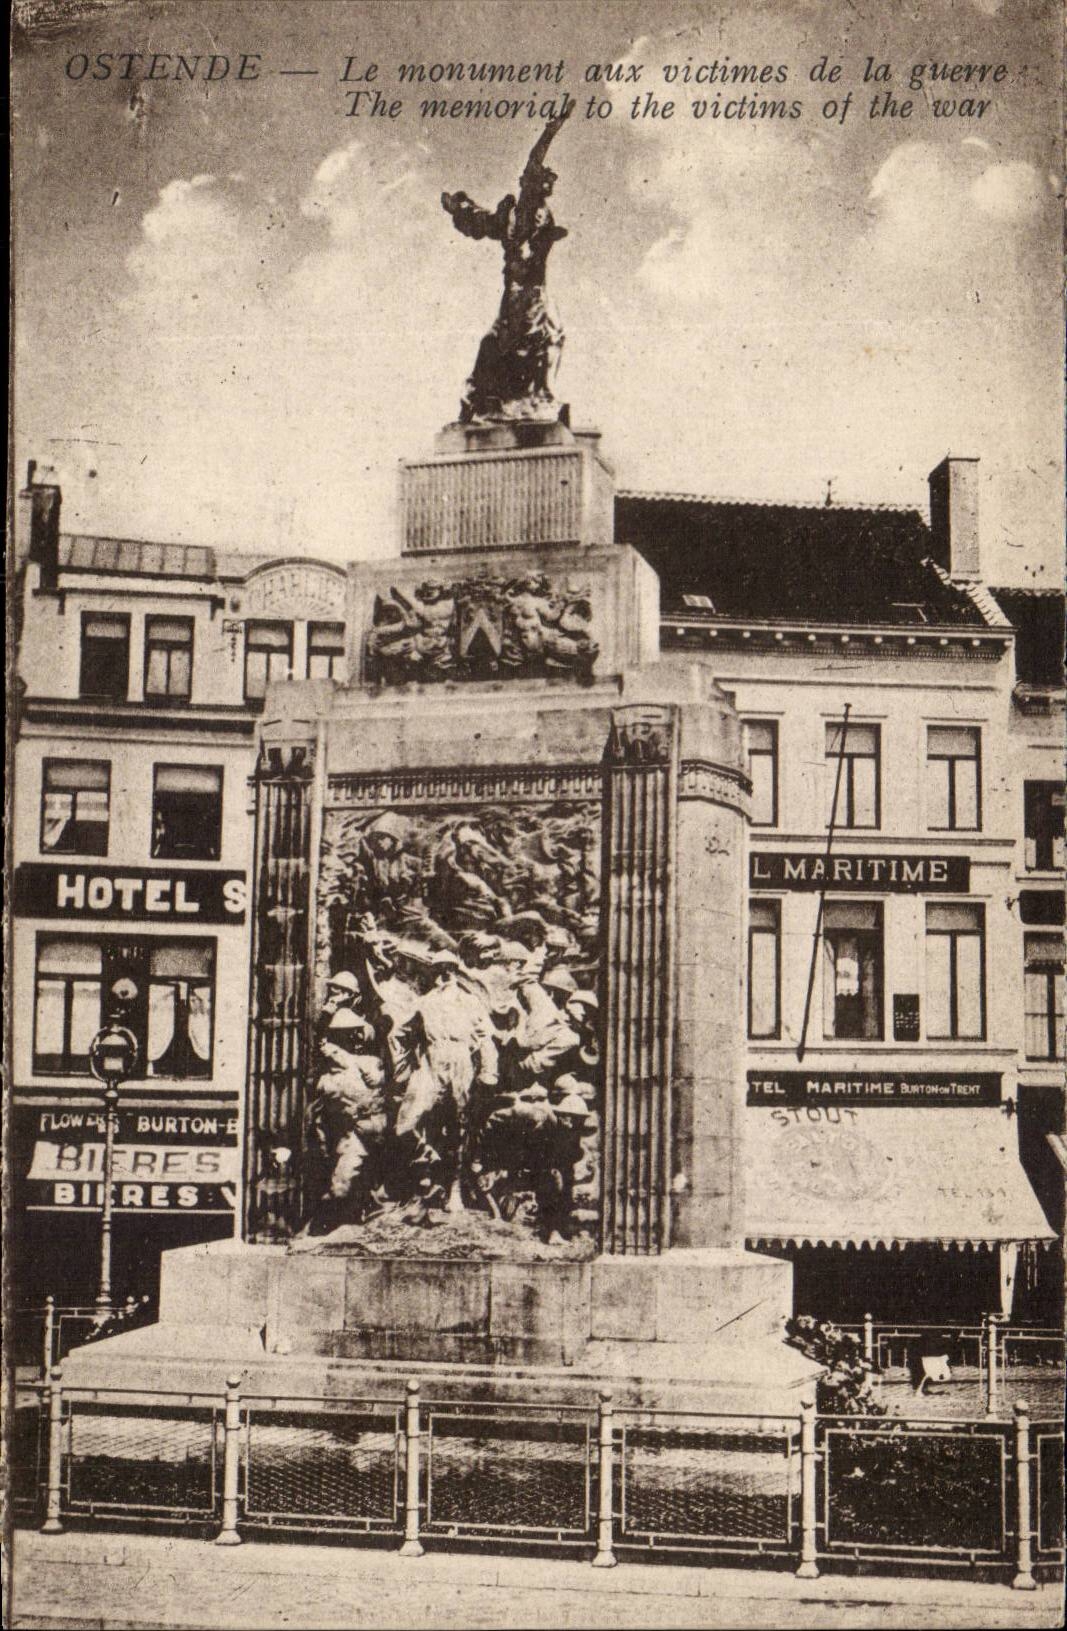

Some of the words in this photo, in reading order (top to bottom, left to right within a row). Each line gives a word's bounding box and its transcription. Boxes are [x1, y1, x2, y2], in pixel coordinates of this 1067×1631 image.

[784, 858, 948, 883] MARITIME
[57, 874, 200, 913] HOTEL
[749, 1080, 786, 1094] TEL
[806, 1080, 895, 1094] MARITIME
[771, 1106, 858, 1127] STOUT
[57, 1144, 221, 1175] BIERES
